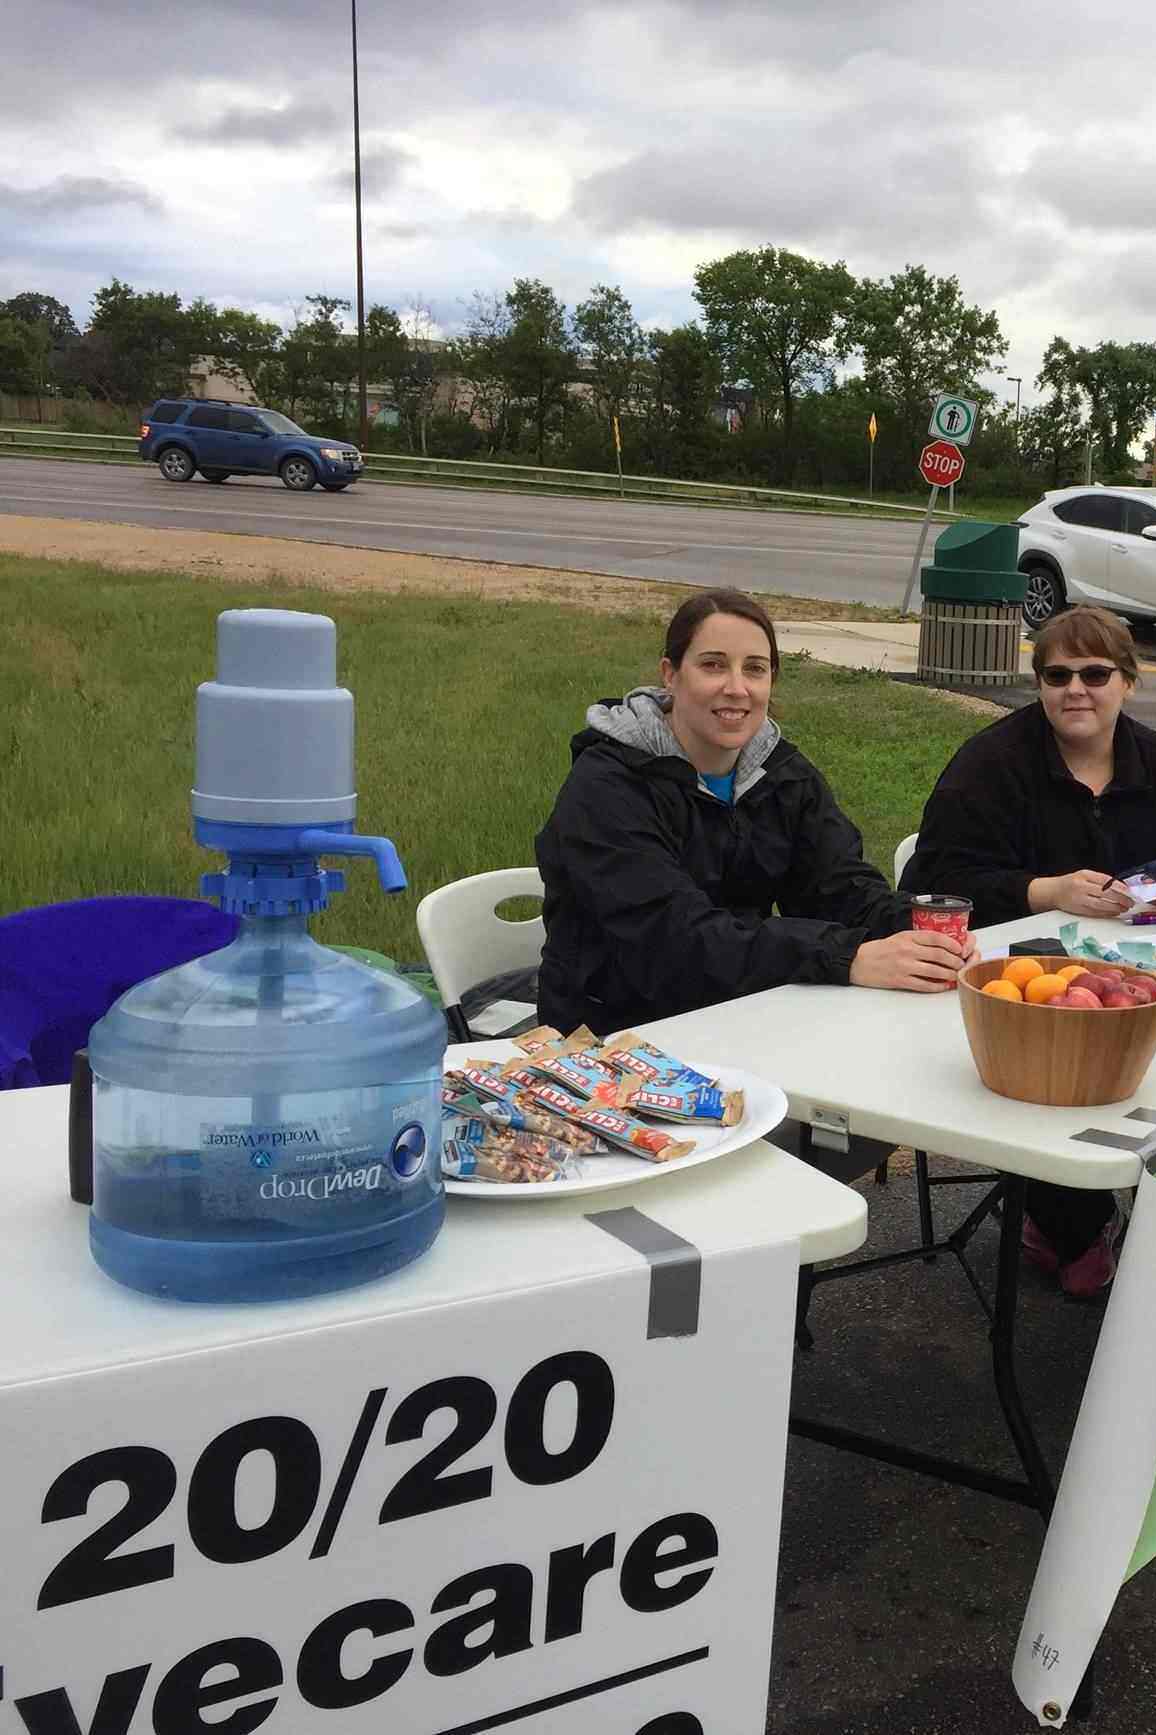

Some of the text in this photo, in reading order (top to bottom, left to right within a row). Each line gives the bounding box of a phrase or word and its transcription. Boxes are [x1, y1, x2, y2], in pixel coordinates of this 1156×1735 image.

[924, 452, 960, 474] STOP
[206, 1131, 262, 1149] Water
[271, 1128, 321, 1148] World
[259, 1162, 383, 1200] DewDrop
[37, 1350, 616, 1611] 20/20
[0, 1512, 719, 1735] yecare
